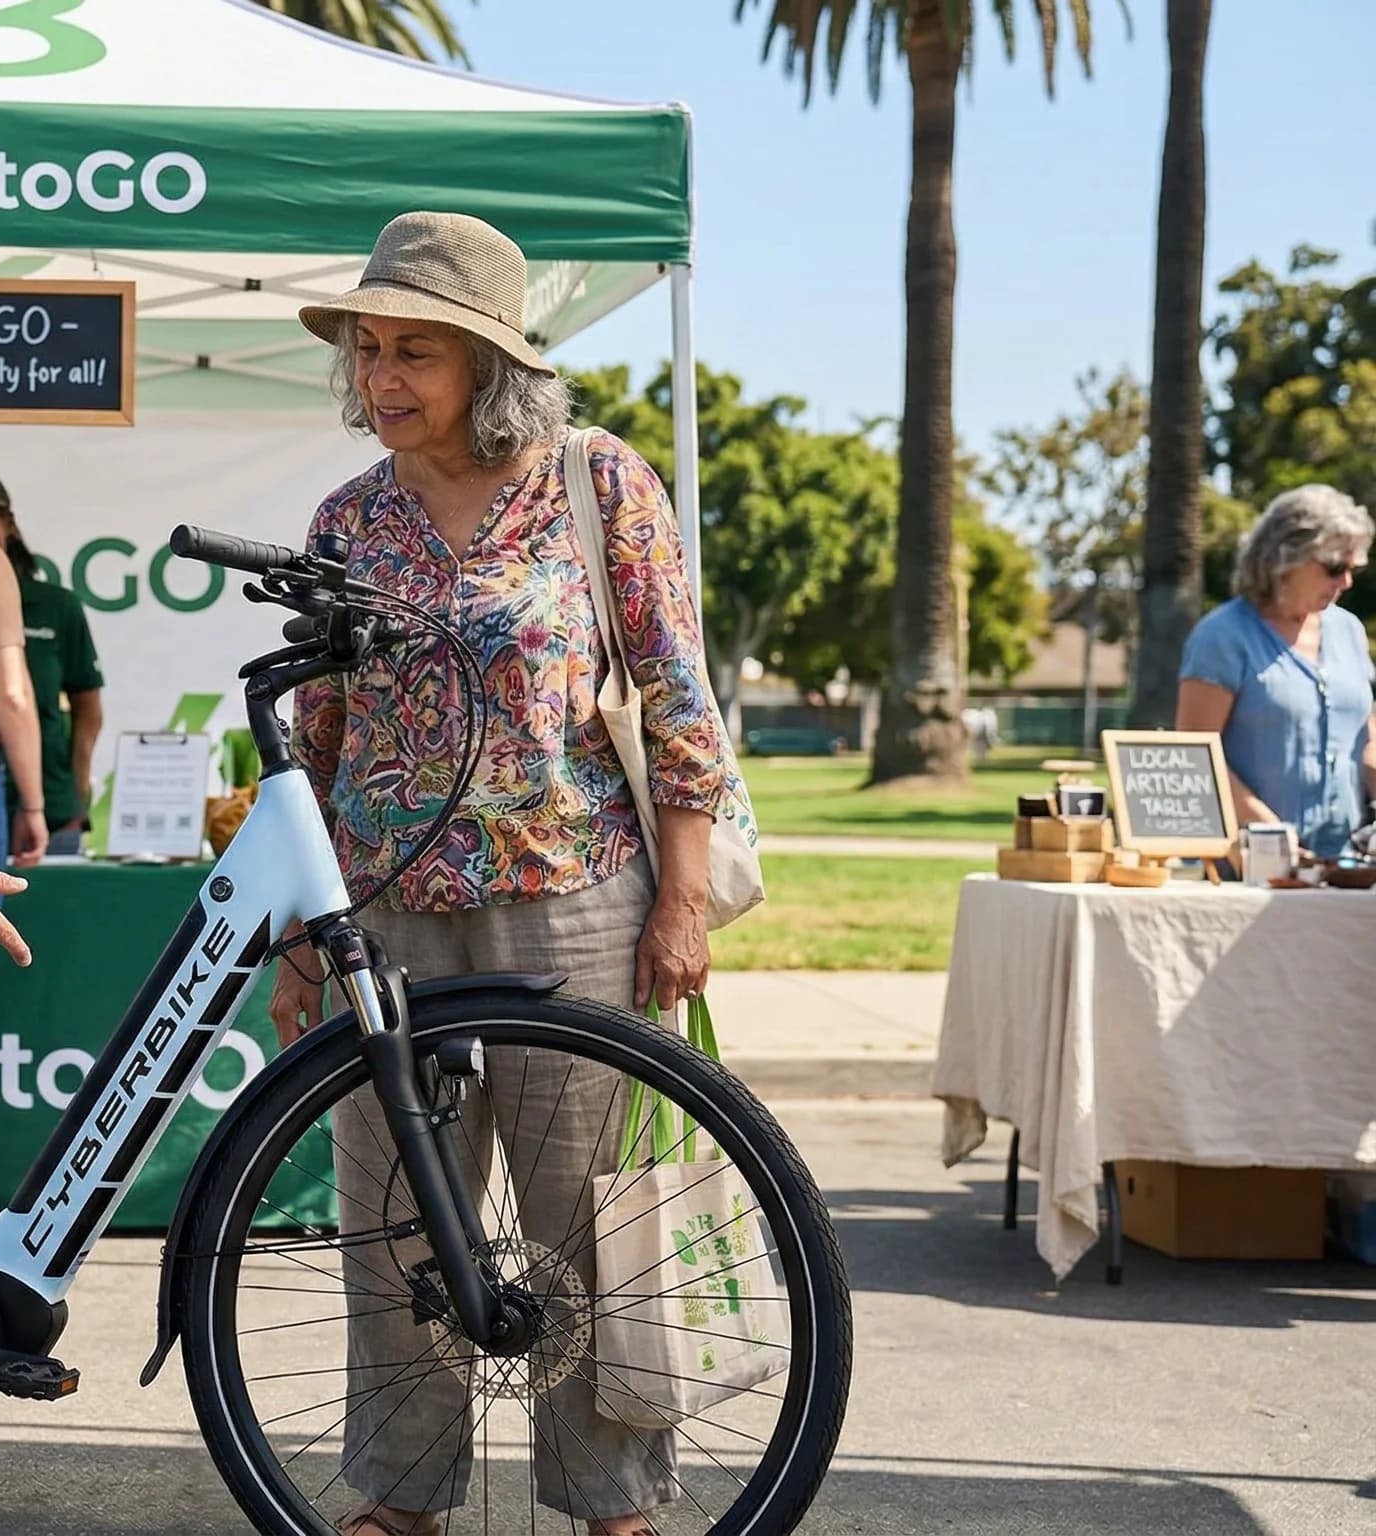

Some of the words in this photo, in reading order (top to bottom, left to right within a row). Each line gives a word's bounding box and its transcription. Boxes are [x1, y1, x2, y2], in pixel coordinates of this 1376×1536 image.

[27, 356, 62, 392] for
[68, 357, 107, 386] all!
[1129, 748, 1196, 769] LOCAL
[1125, 772, 1212, 795] ARTISAN
[21, 916, 237, 1258] CYBERBIKE
